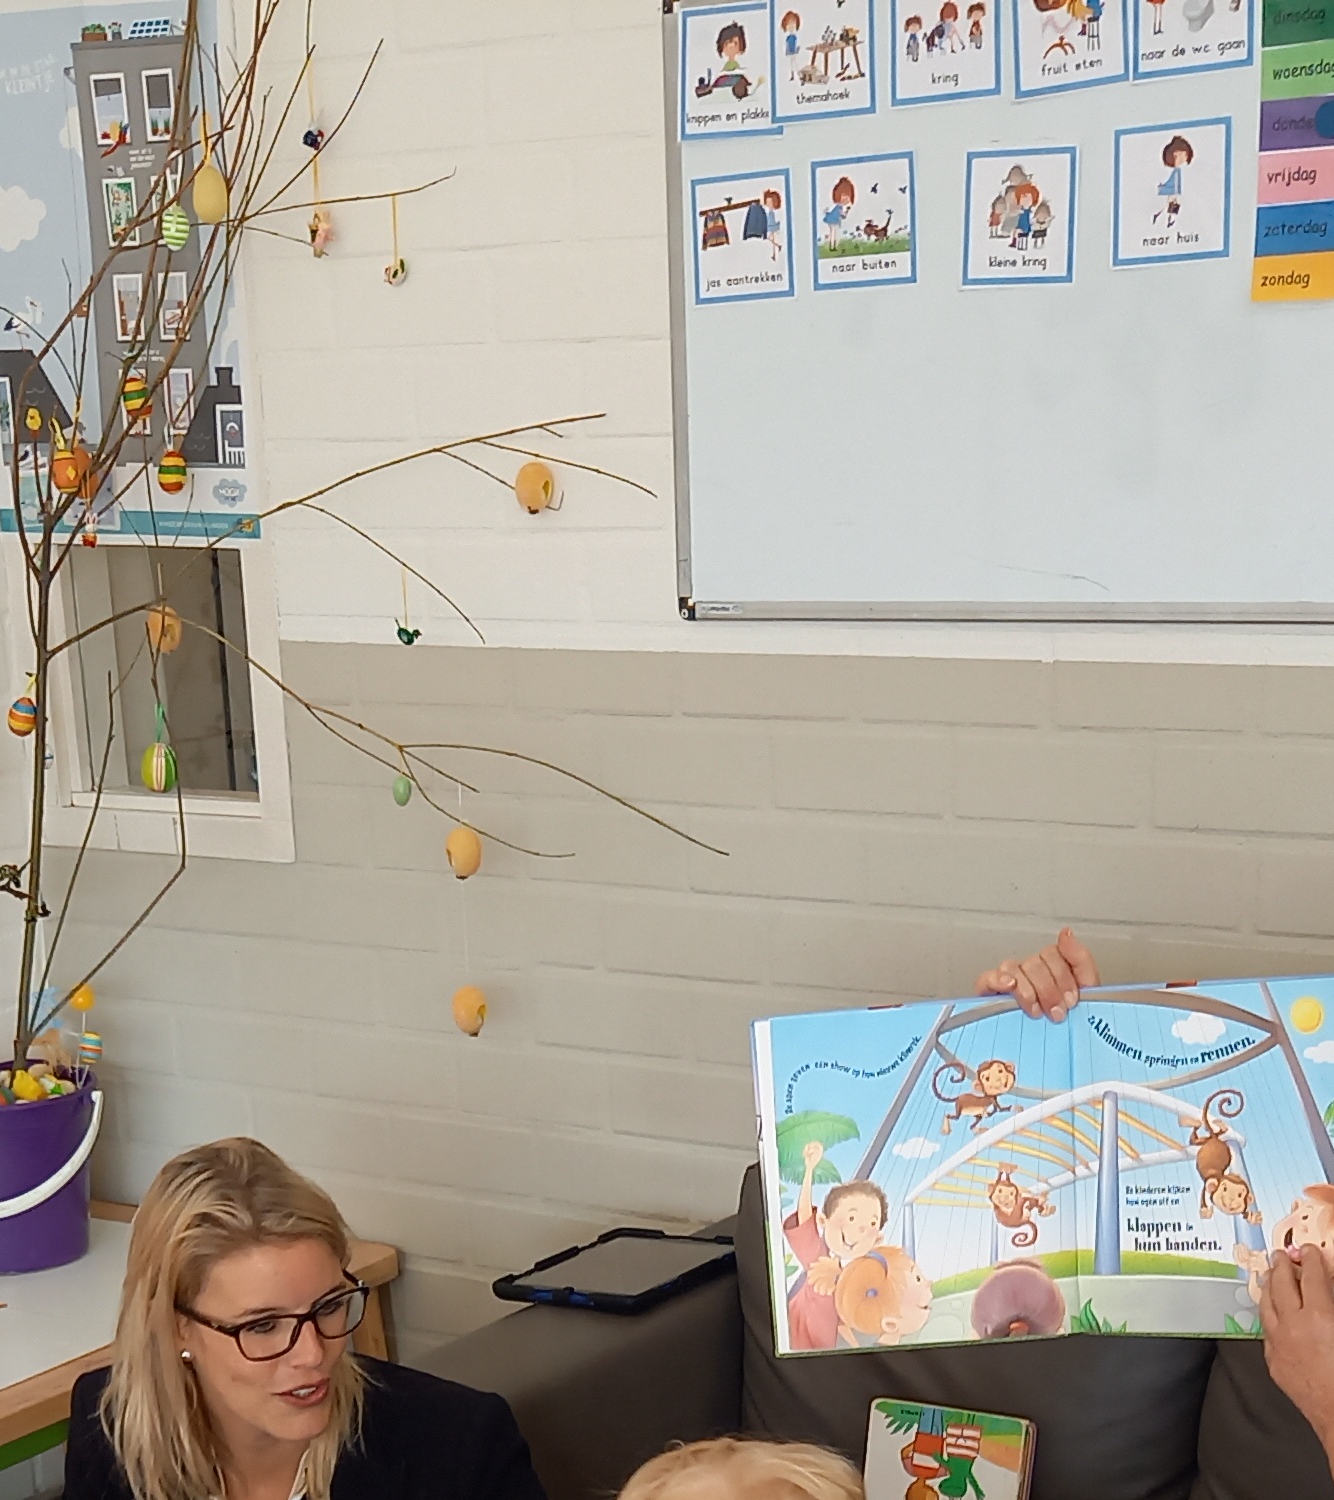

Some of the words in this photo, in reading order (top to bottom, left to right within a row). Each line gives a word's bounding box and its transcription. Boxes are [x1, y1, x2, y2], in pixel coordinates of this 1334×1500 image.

[1273, 6, 1326, 25] dinsdag
[1140, 48, 1165, 61] naar
[1171, 44, 1186, 57] de
[1192, 43, 1210, 55] wc
[1217, 40, 1245, 55] gaan
[1041, 61, 1068, 77] fruit
[1075, 58, 1103, 72] eten
[931, 72, 959, 86] kring
[796, 89, 850, 105] themahoek
[686, 113, 722, 127] knippen
[725, 113, 738, 122] en
[1272, 112, 1315, 132] donde
[1267, 167, 1317, 187] vrijdag
[1263, 219, 1328, 238] zaterdag
[1142, 236, 1170, 247] naar
[1177, 232, 1200, 244] huis
[832, 261, 856, 273] naar
[862, 258, 897, 270] buiten
[988, 256, 1017, 268] kleine
[1022, 255, 1047, 270] kring
[706, 277, 721, 292] jas
[726, 271, 784, 287] aantrekken
[1260, 271, 1310, 288] zondag
[1094, 1018, 1142, 1061] klimmen
[1144, 1055, 1188, 1070] springen
[1200, 1036, 1256, 1063] rennen.
[1127, 1217, 1182, 1238] klappen
[1134, 1237, 1161, 1252] hun
[1166, 1236, 1222, 1252] handen.
